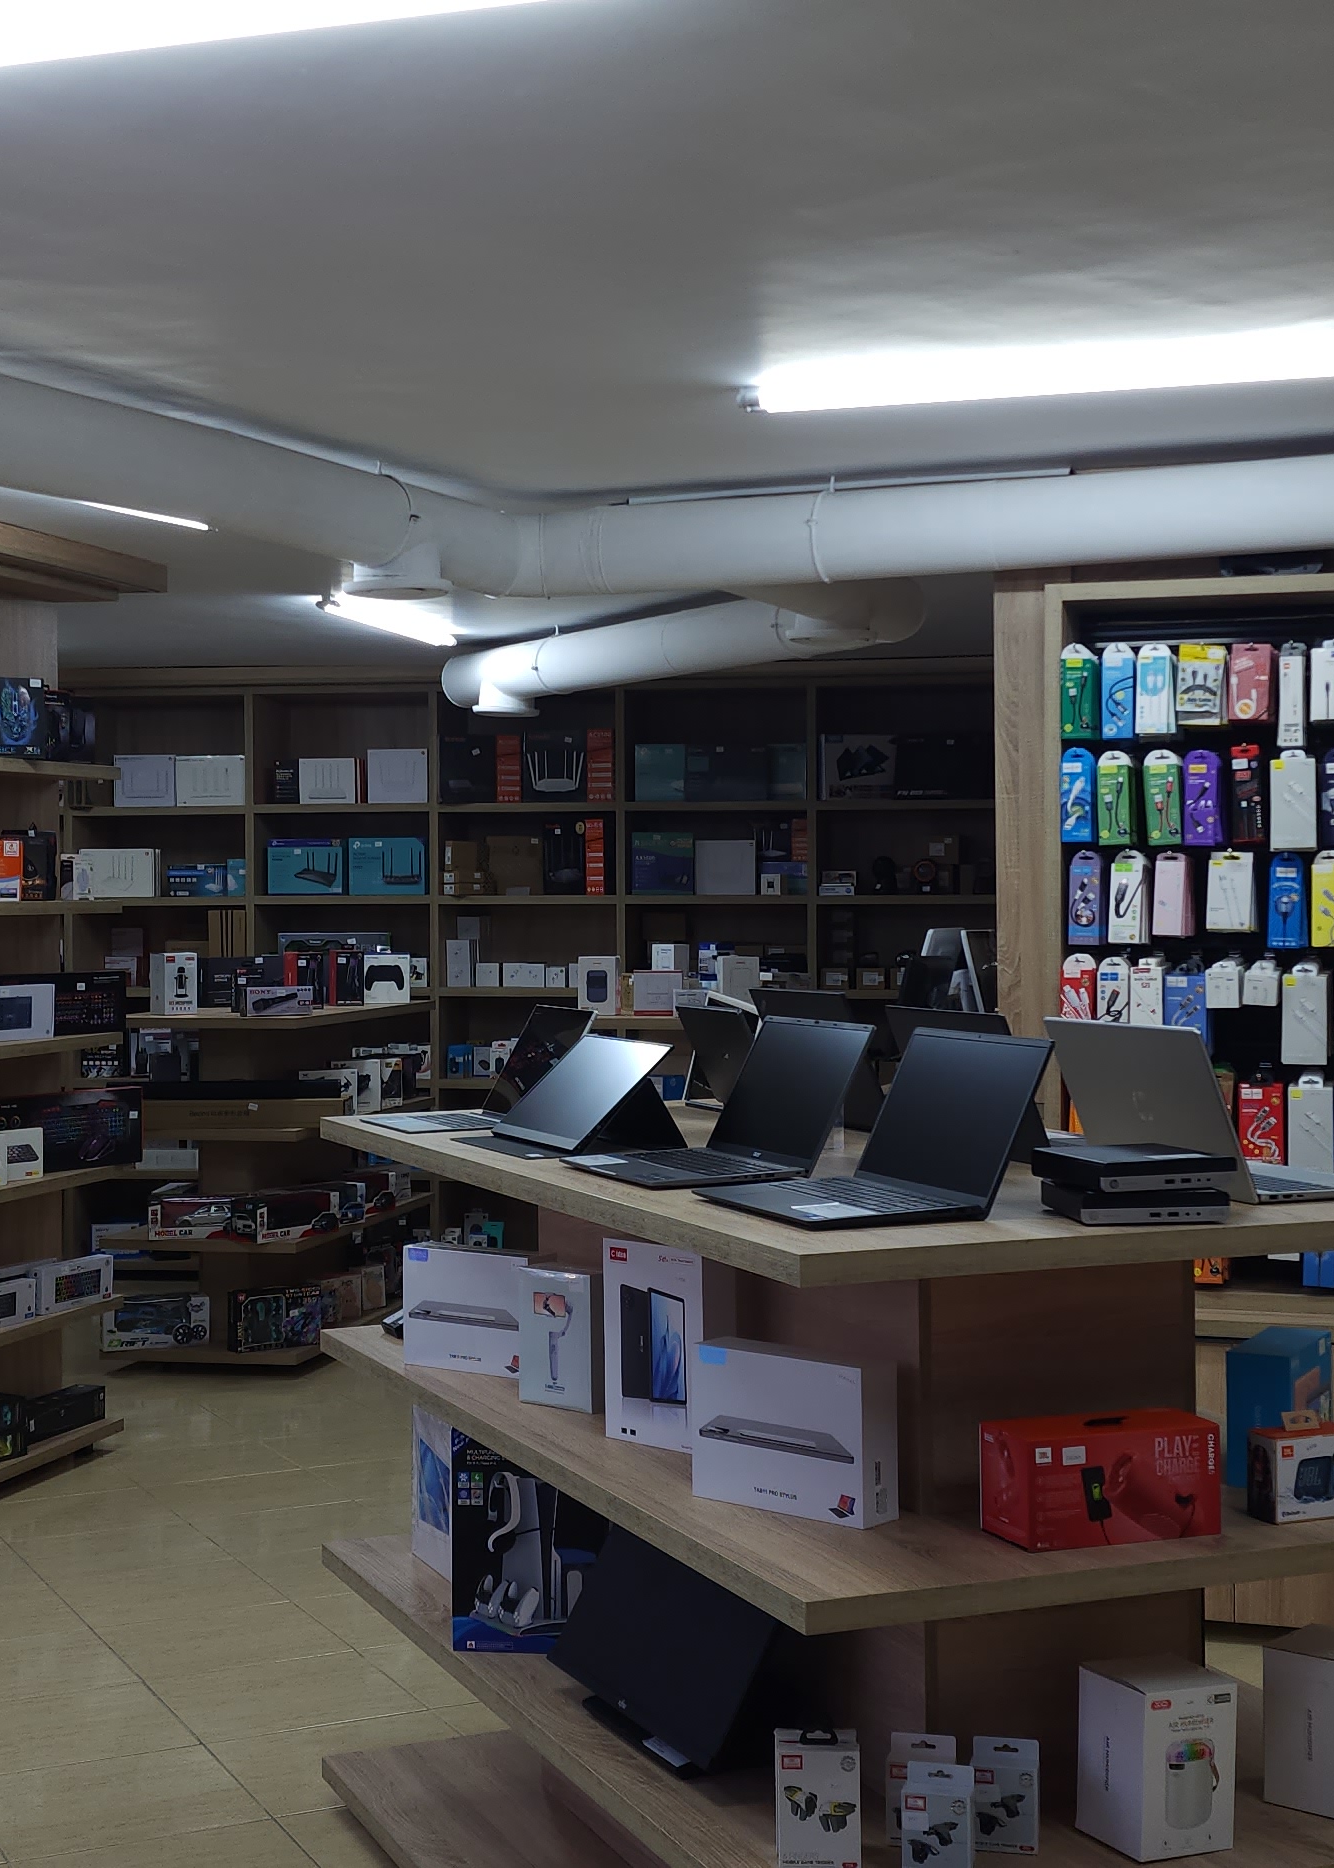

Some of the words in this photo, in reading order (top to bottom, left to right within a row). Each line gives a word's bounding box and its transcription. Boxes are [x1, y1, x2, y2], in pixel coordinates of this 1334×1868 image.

[1155, 1435, 1192, 1459] PLAY
[1156, 1456, 1200, 1476] CHARGE
[1298, 1465, 1321, 1488] JBL
